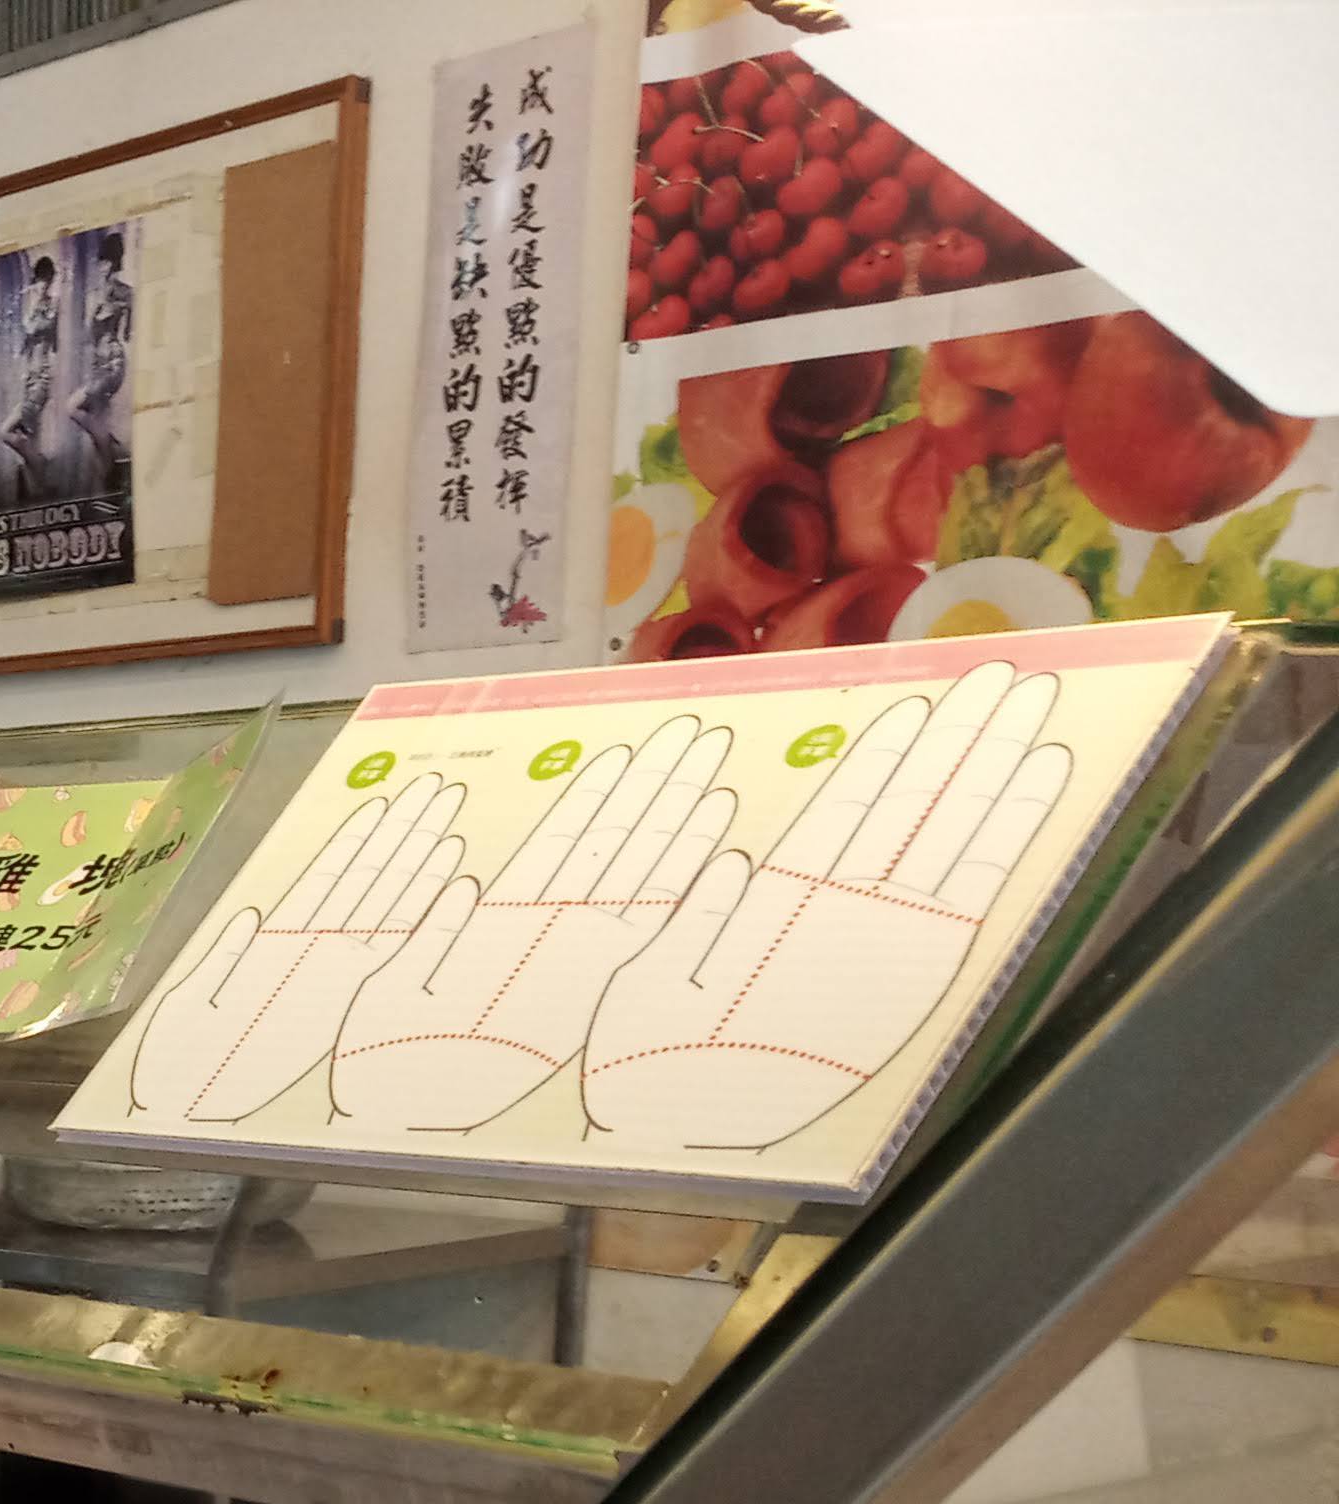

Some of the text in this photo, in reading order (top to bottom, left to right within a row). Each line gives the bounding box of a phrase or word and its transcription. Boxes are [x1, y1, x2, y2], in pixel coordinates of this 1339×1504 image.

[439, 83, 495, 522] 失敗是缺點的累積
[494, 66, 554, 515] 成功是優點的發揮
[11, 521, 126, 574] NOBODY
